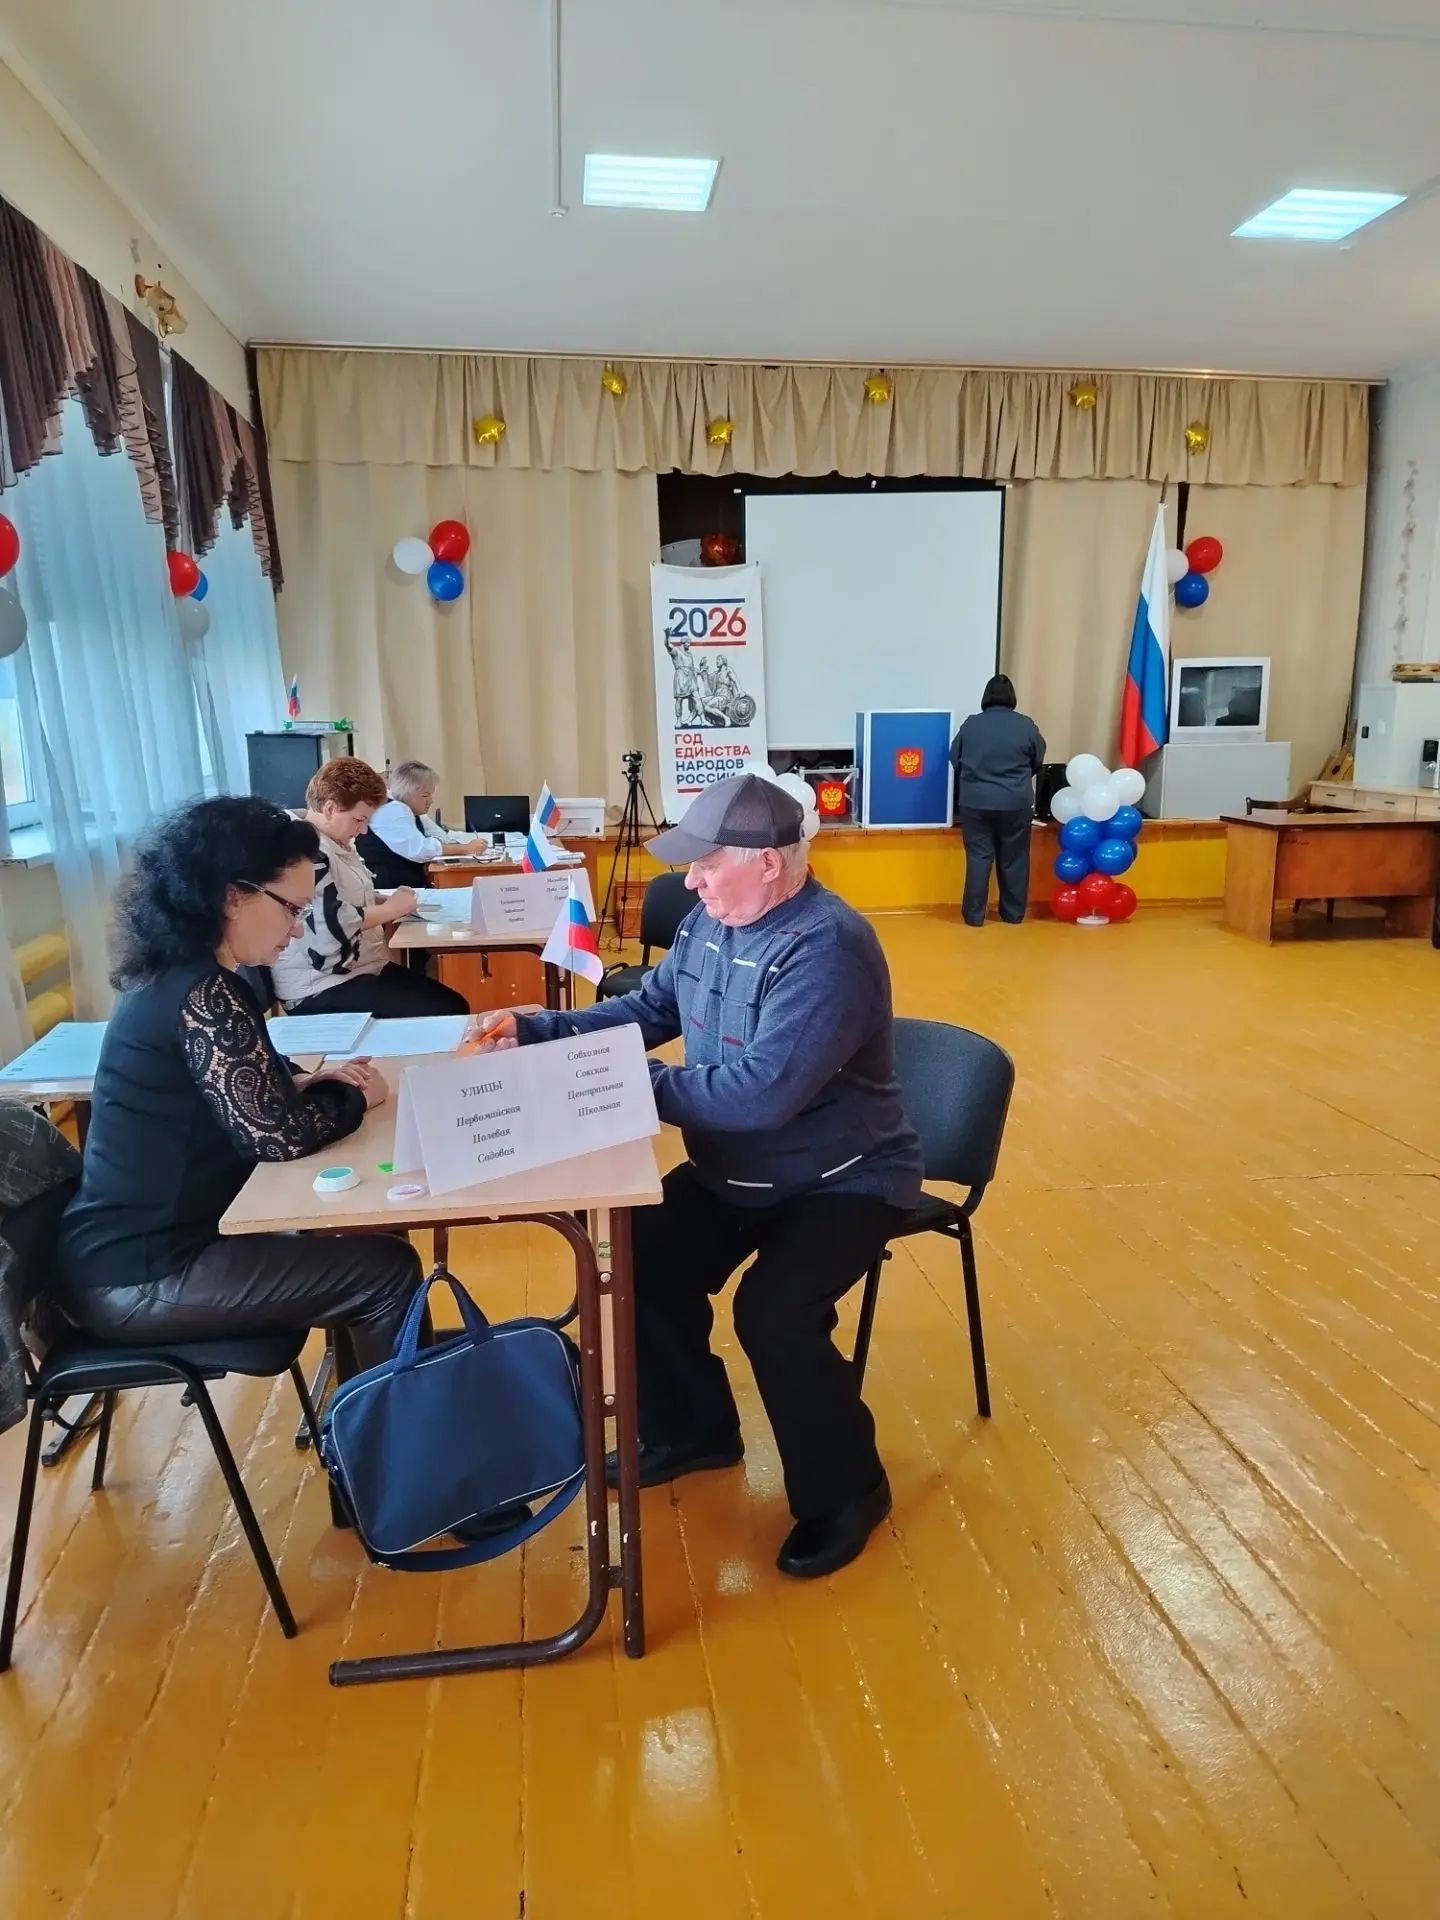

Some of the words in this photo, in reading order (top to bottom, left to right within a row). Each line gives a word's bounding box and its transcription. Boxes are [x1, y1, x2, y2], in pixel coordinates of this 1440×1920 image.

[668, 606, 747, 638] 2026
[674, 733, 704, 745] ГОД
[675, 745, 751, 759] ЕДИНСТВА
[676, 758, 745, 772] НАРОДОВ
[575, 1066, 609, 1078] Сокская
[460, 1080, 503, 1098] УЛИЦЫ
[567, 1081, 624, 1100] Центральная
[456, 1105, 521, 1128] Первомайская
[578, 1100, 621, 1117] Школьная
[473, 1128, 511, 1144] Полевая
[477, 1147, 515, 1163] Садовая
